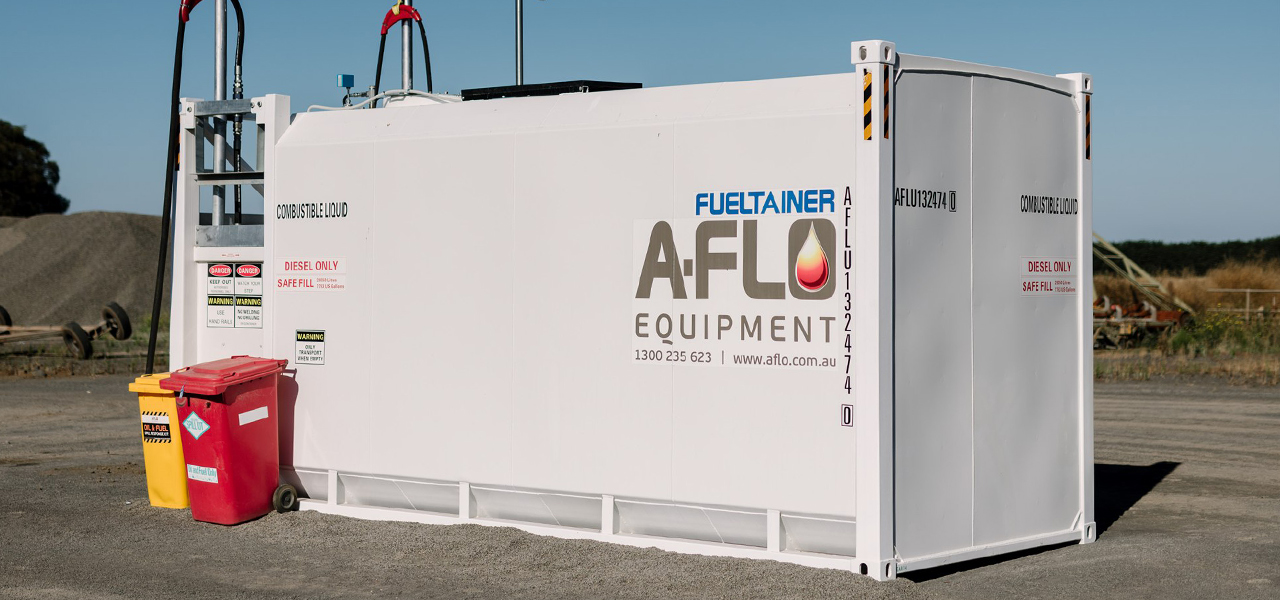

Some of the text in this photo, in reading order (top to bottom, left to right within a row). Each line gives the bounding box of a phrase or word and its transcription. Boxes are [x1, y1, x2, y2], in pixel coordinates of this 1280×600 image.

[695, 189, 835, 215] FUELTAINER
[894, 187, 947, 210] AFLU132474
[1021, 195, 1078, 215] COMBUSTIBLE LIQUID
[276, 202, 348, 219] COMBUSTIBLE LIQUID
[284, 260, 338, 271] DIESEL ONLY
[1028, 261, 1072, 272] DIESEL ONLY
[277, 278, 297, 287] SAFE
[298, 278, 314, 287] FILL
[1022, 281, 1039, 292] SAFE
[1040, 281, 1053, 291] FILL
[635, 313, 836, 345] EQUIPMENT
[635, 350, 836, 367] 1300 235 623 www.aflo.com.au
